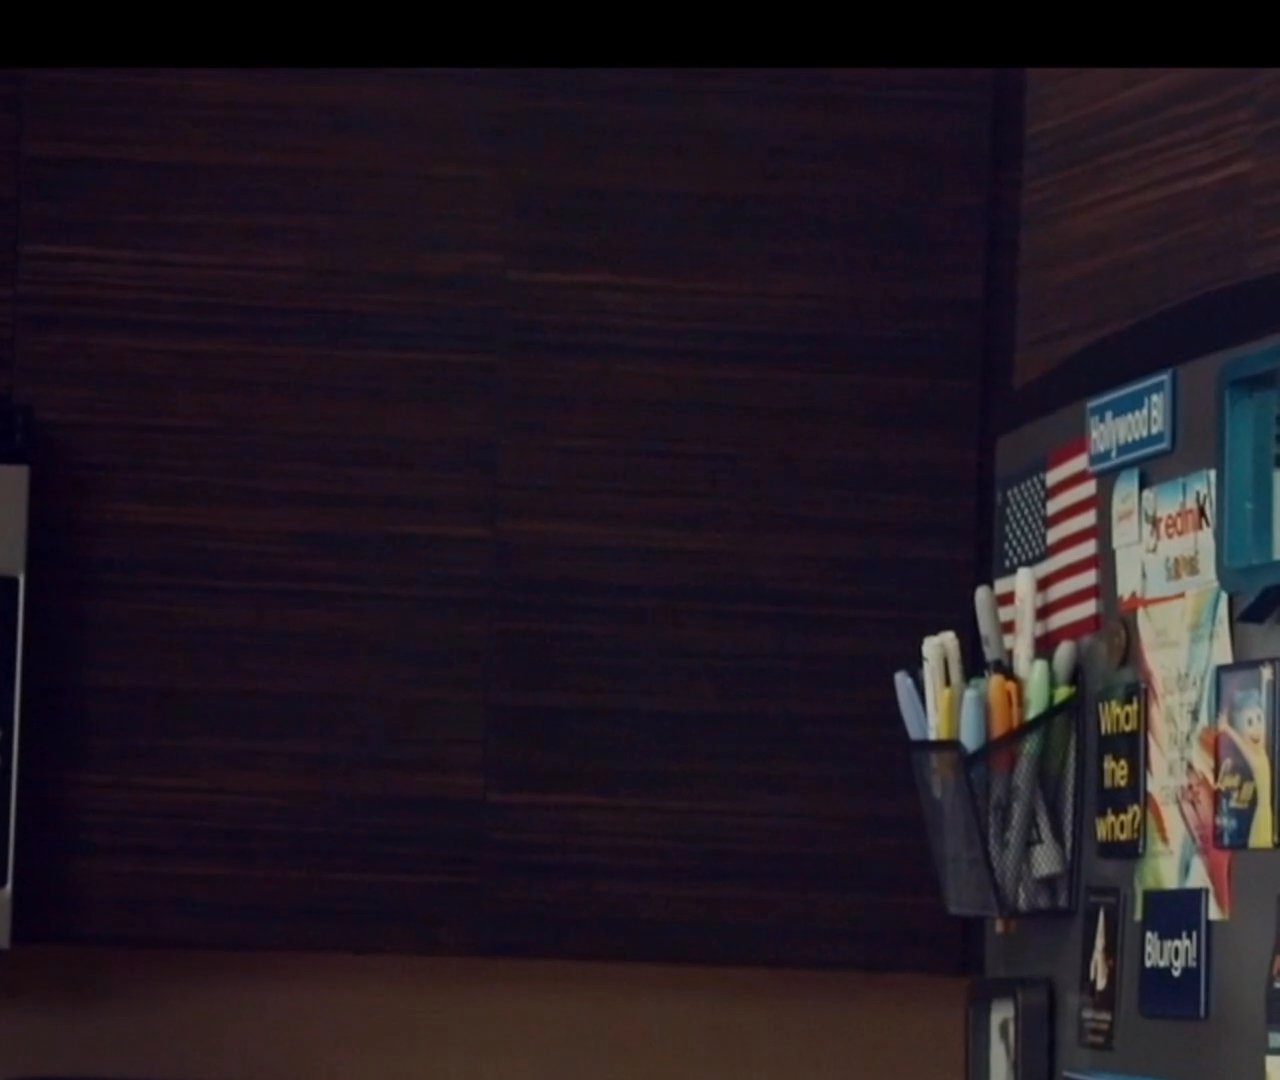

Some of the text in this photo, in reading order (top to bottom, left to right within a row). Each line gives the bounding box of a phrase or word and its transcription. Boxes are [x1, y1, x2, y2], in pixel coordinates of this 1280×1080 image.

[1089, 395, 1149, 459] Hollywood
[1098, 696, 1139, 737] What
[1103, 753, 1129, 790] the
[1095, 804, 1141, 843] what?
[1144, 930, 1198, 978] Blurgh!
